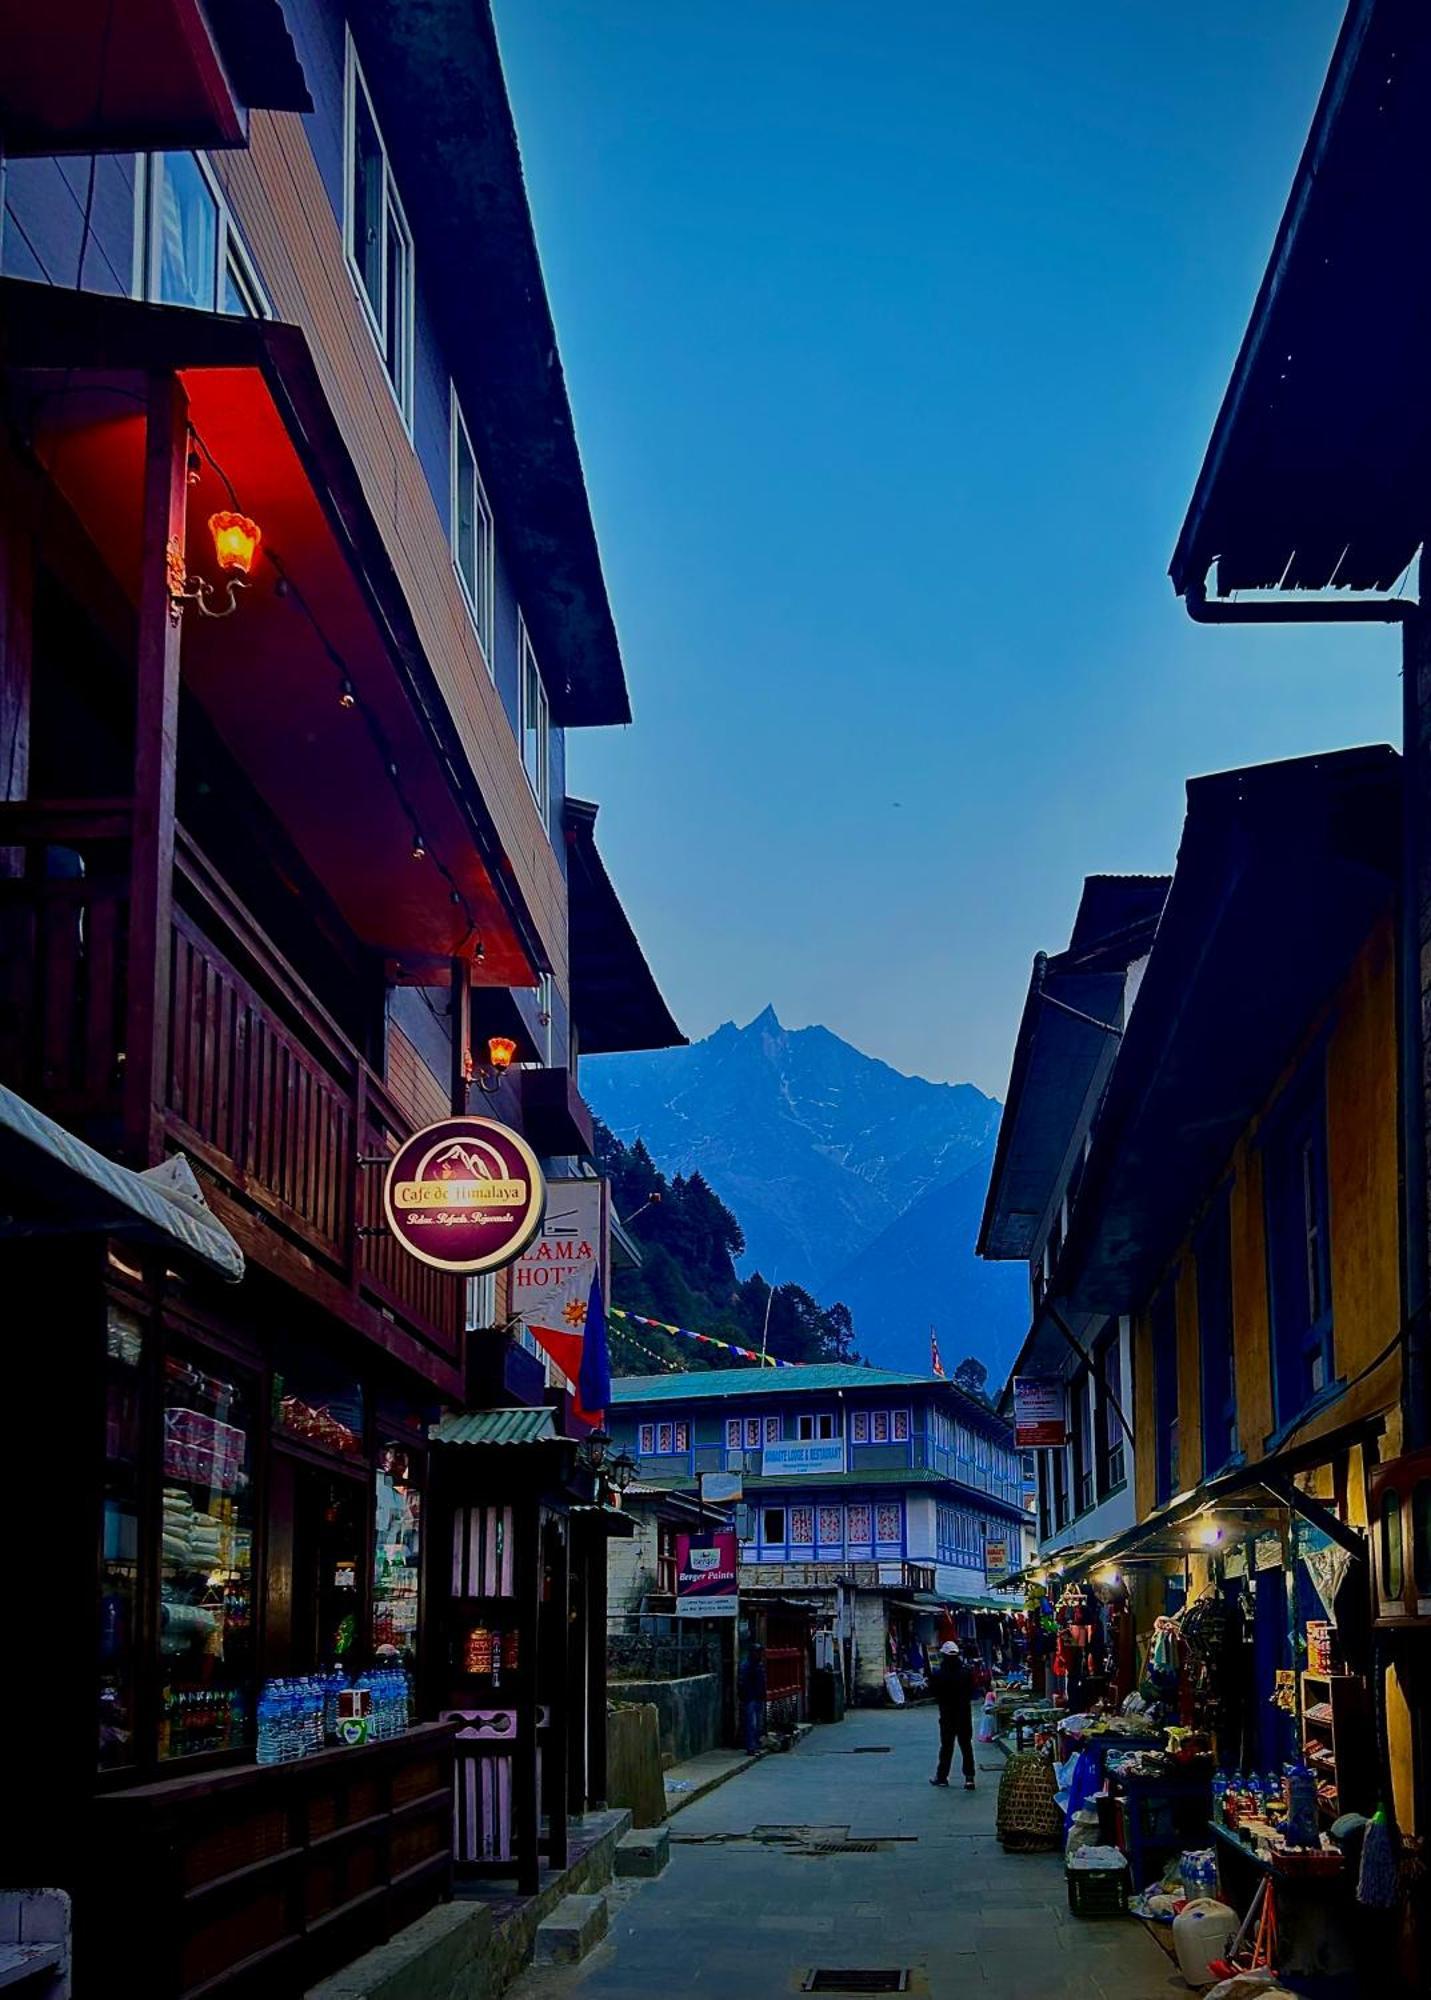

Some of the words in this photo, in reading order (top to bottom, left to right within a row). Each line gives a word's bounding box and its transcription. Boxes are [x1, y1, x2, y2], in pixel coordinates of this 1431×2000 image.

[456, 1185, 519, 1202] Himalaya
[679, 1572, 706, 1582] Berger
[707, 1570, 735, 1580] Paints
